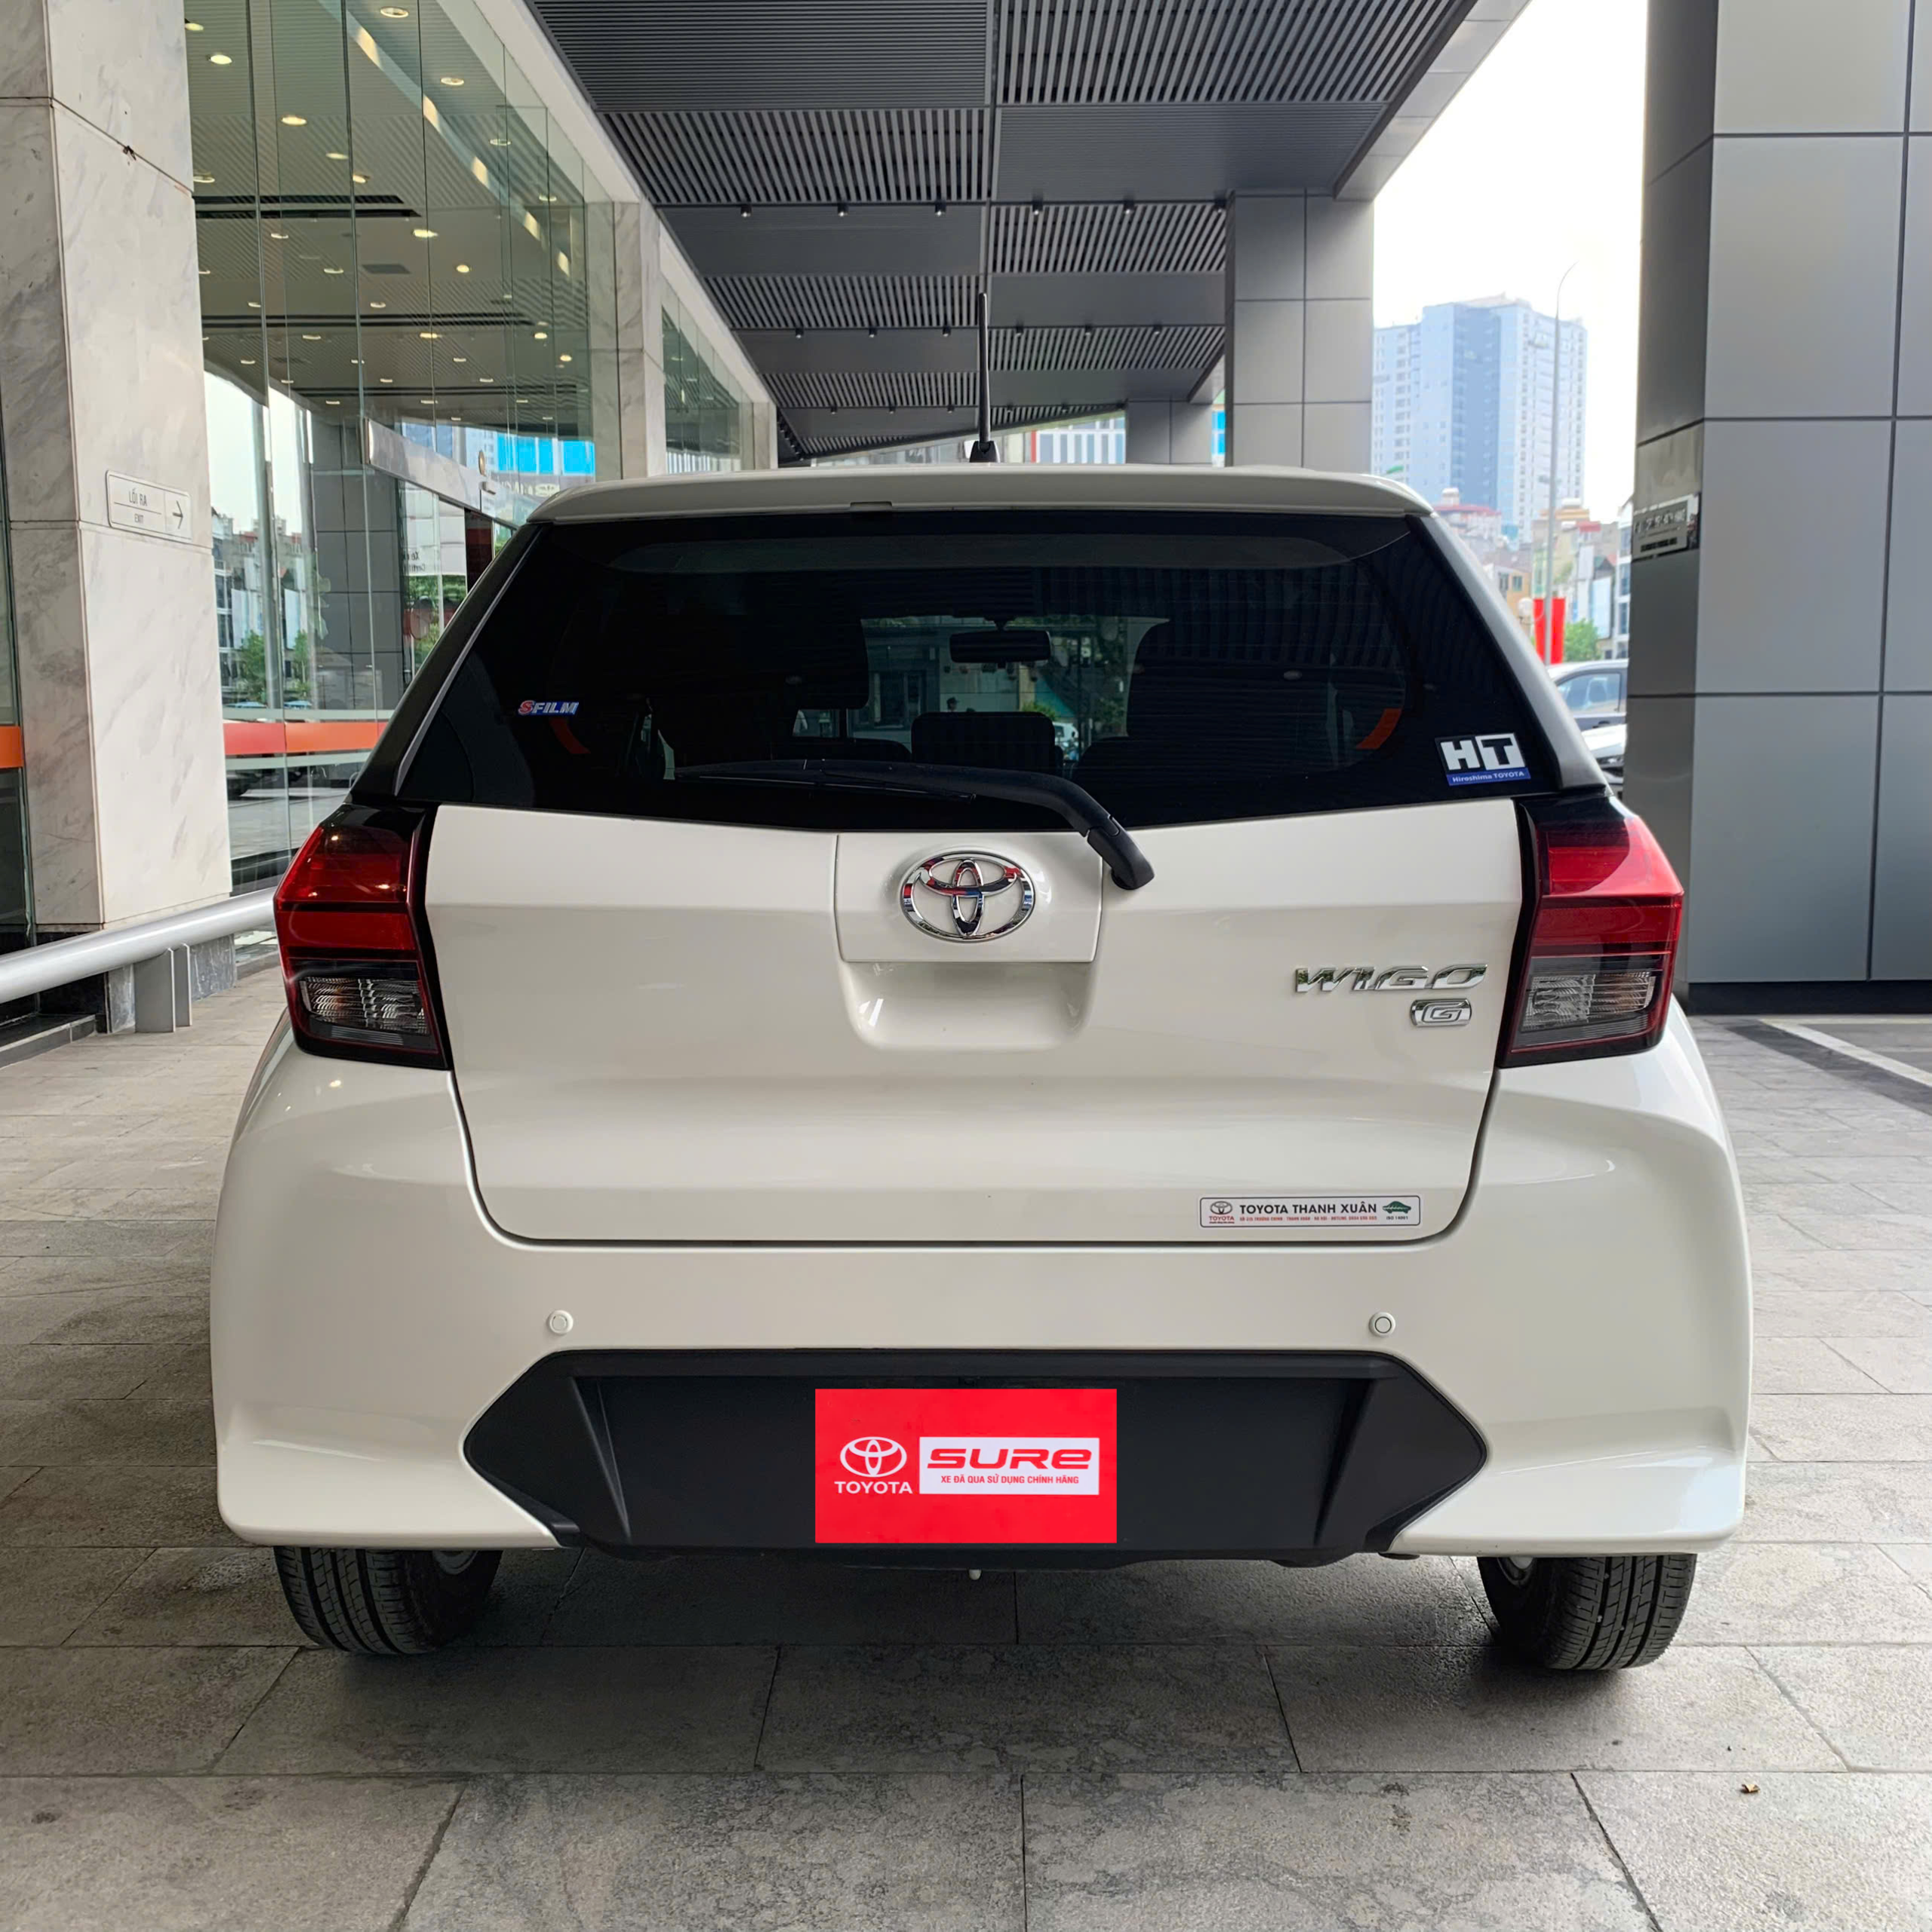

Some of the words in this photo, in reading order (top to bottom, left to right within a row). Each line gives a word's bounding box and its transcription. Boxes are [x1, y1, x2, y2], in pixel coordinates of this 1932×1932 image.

[140, 493, 148, 506] RA
[134, 513, 144, 524] EXIT
[518, 700, 579, 715] SFILM
[1440, 737, 1514, 770] HT
[1452, 774, 1492, 783] Hiroshima
[1494, 771, 1524, 779] TOYOTA
[1295, 964, 1488, 992] WIGO
[1420, 1000, 1467, 1024] G
[1239, 1204, 1288, 1214] TOYOTA
[1292, 1204, 1336, 1214] THANH
[1340, 1201, 1377, 1214] XUÂN
[940, 1475, 952, 1484] XE
[953, 1474, 965, 1484] ĐÃ
[968, 1475, 985, 1484] QUA
[987, 1473, 999, 1484] SỬ
[1001, 1475, 1025, 1485] DỤNG
[1027, 1474, 1054, 1484] CHÍNH
[834, 1481, 913, 1494] TOYOTA
